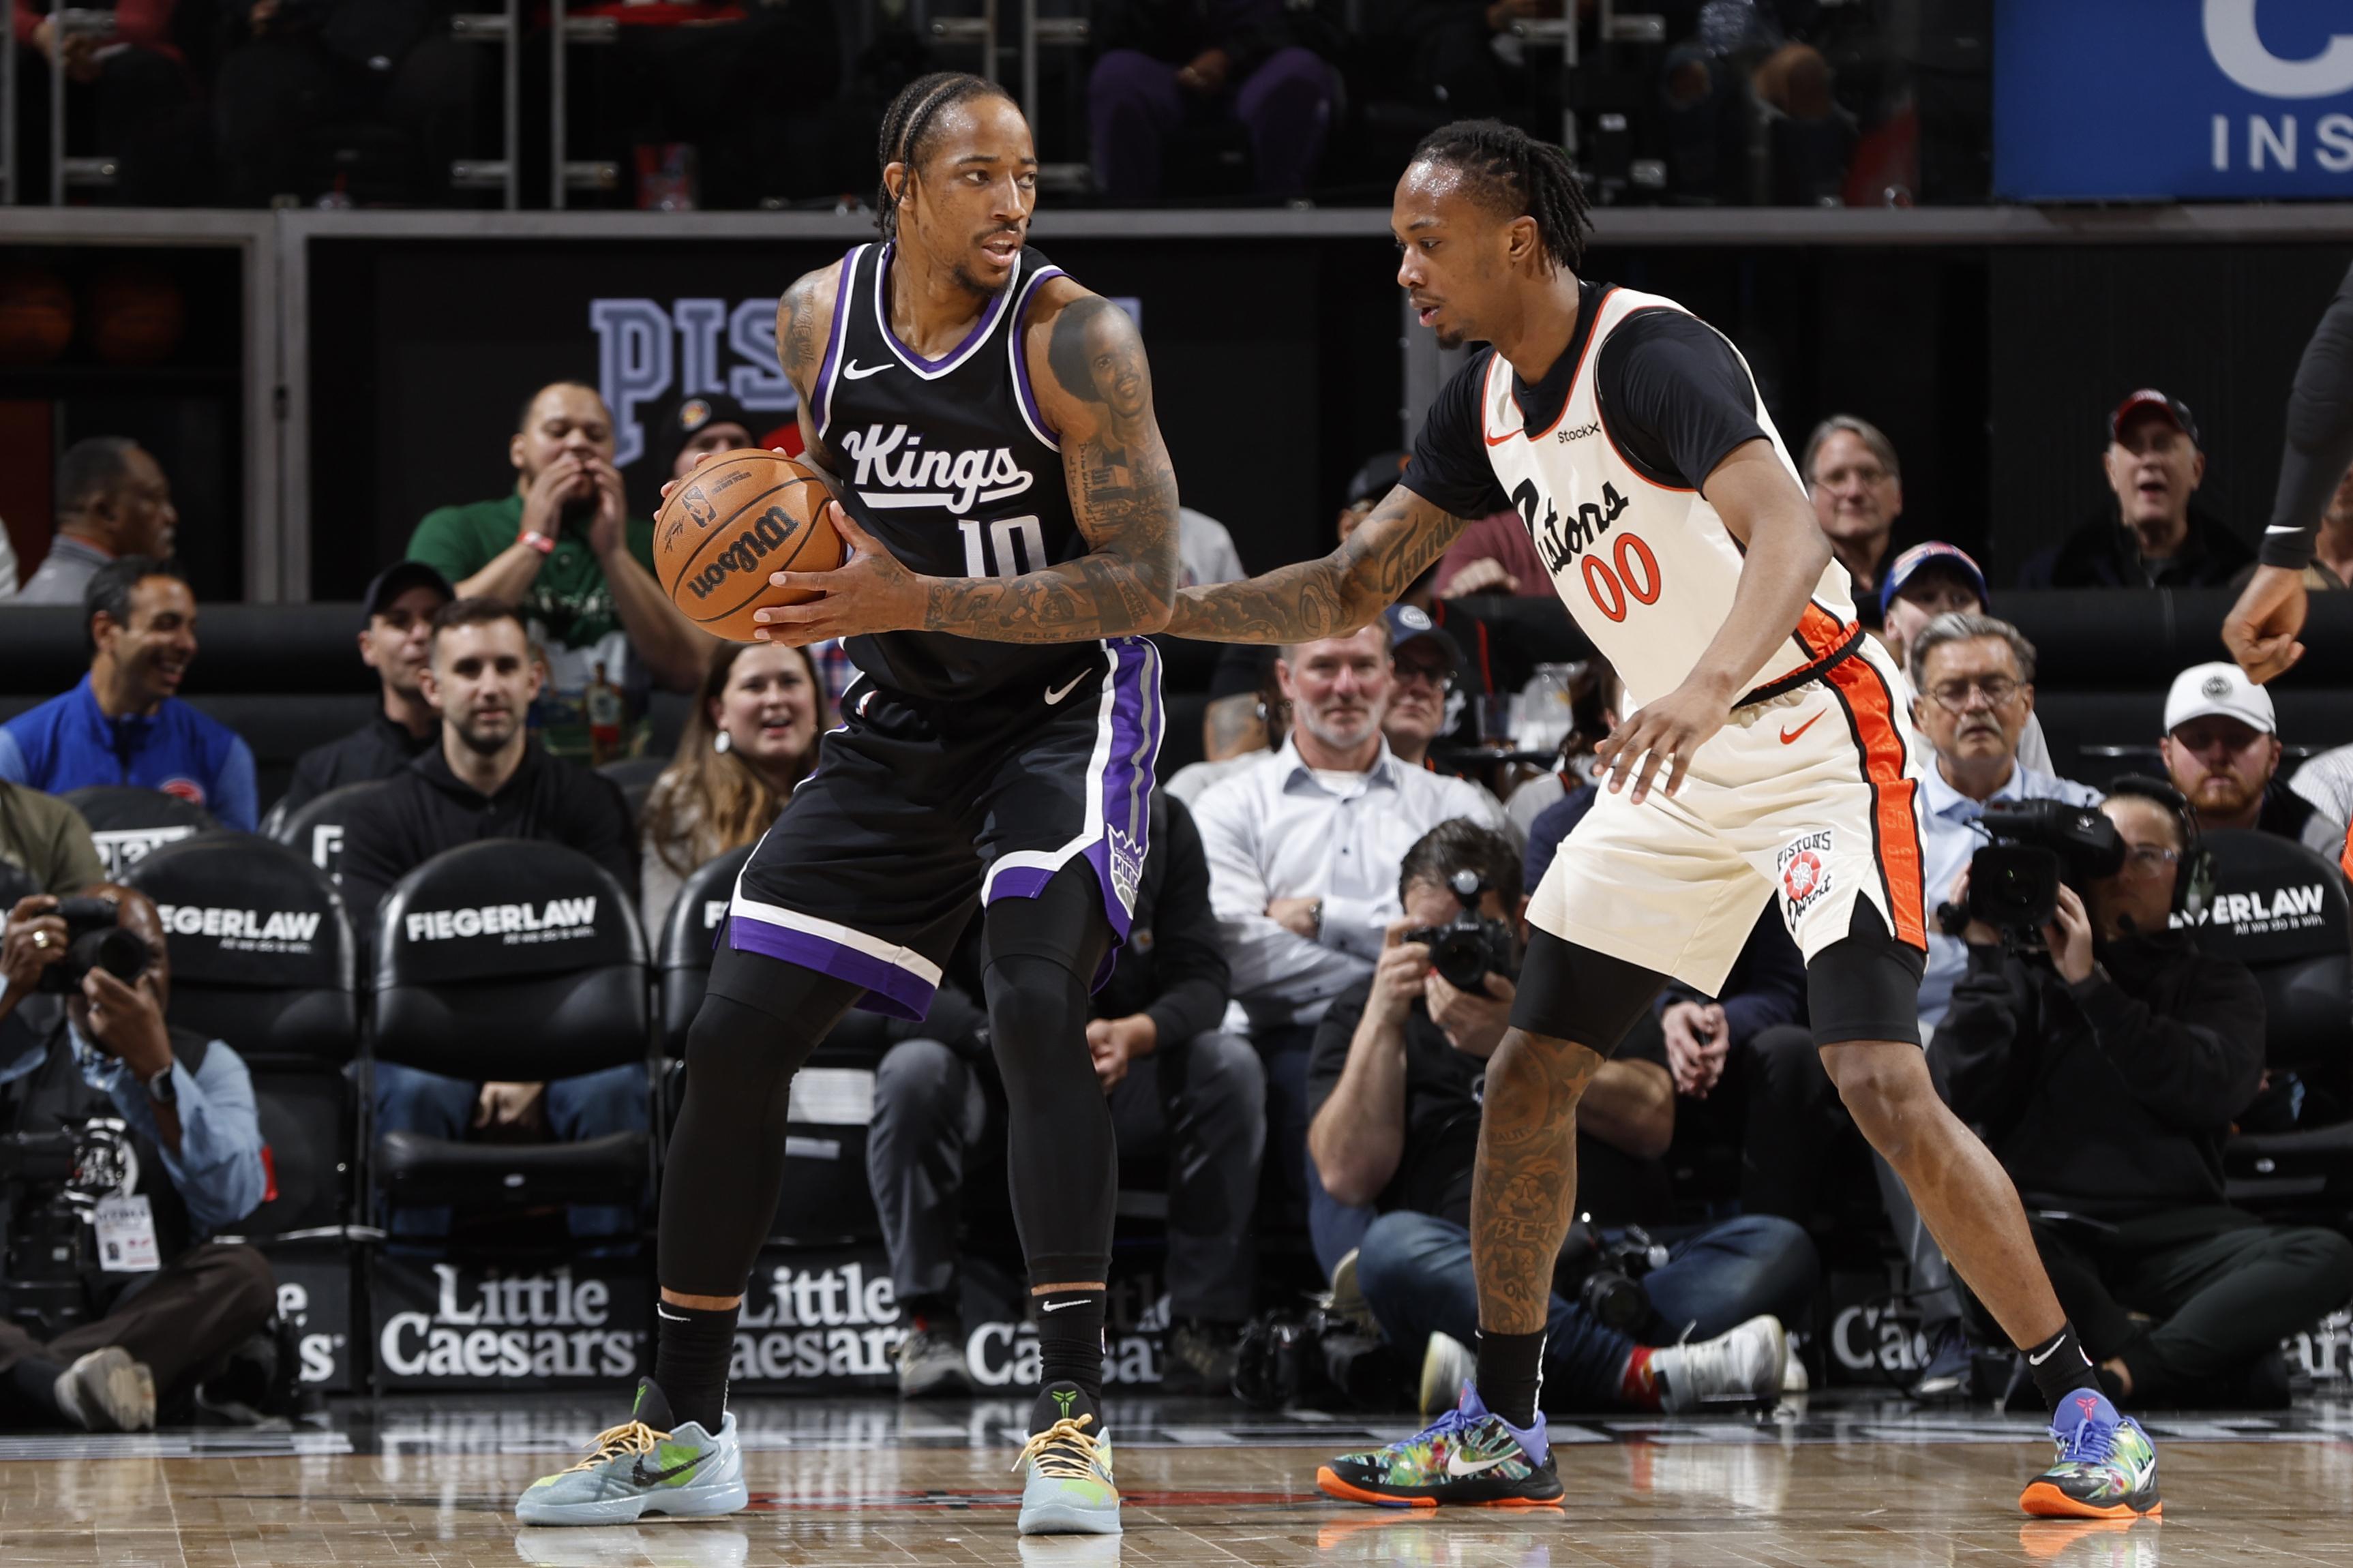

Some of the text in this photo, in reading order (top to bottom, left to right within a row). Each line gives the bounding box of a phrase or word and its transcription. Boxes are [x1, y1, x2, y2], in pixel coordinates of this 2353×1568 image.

[1557, 422, 1601, 443] StockX
[841, 423, 1034, 514] Kings
[686, 505, 801, 601] Wilson
[957, 514, 1048, 578] 10
[1581, 532, 1662, 622] 00
[1777, 830, 1831, 873] PISTONS
[406, 895, 597, 942] FIEGERLAW
[433, 1263, 610, 1326] Little
[736, 1261, 901, 1329] Little
[380, 1311, 638, 1377] Caesars
[728, 1325, 912, 1381] aesar
